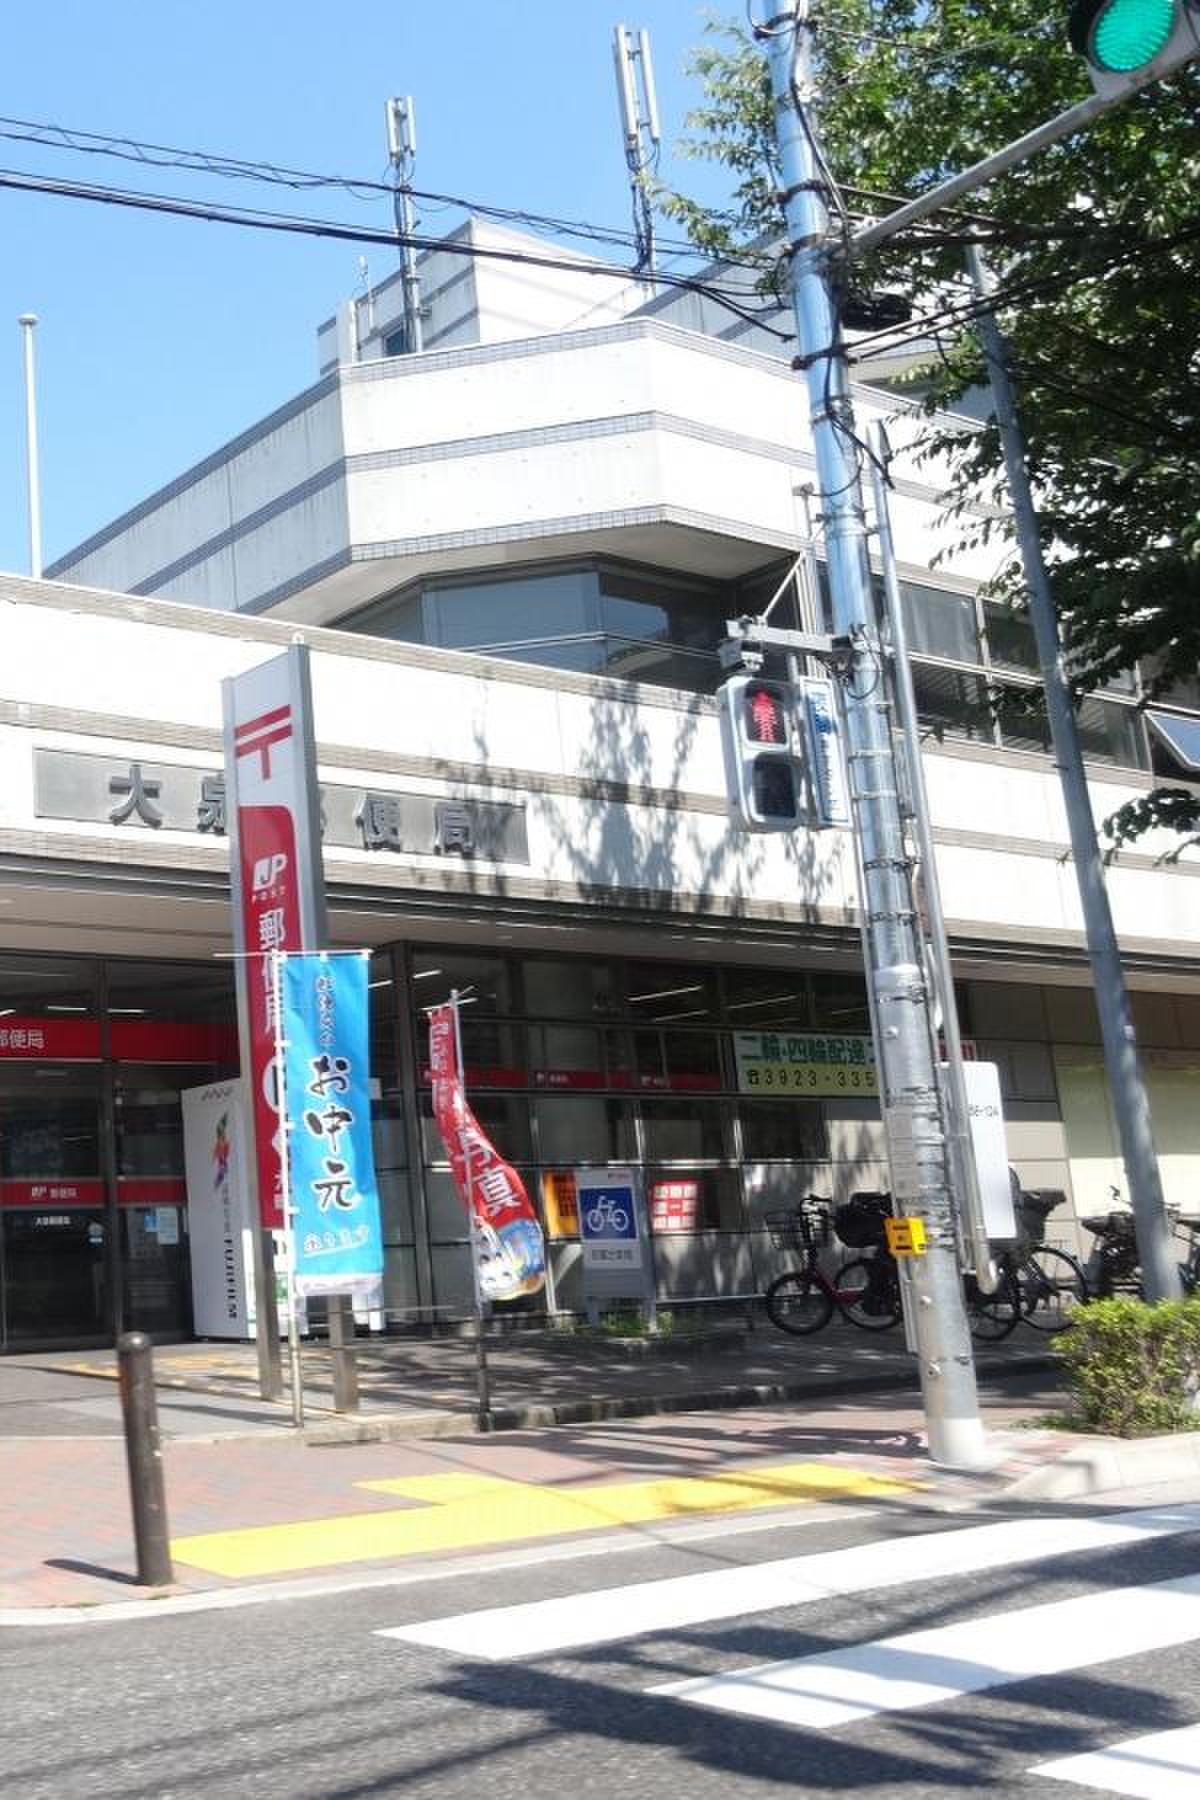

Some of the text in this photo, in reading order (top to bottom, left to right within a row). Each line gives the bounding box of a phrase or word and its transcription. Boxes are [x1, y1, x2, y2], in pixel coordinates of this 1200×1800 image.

[108, 763, 476, 857] 大泉便局
[304, 1055, 354, 1212] お中元
